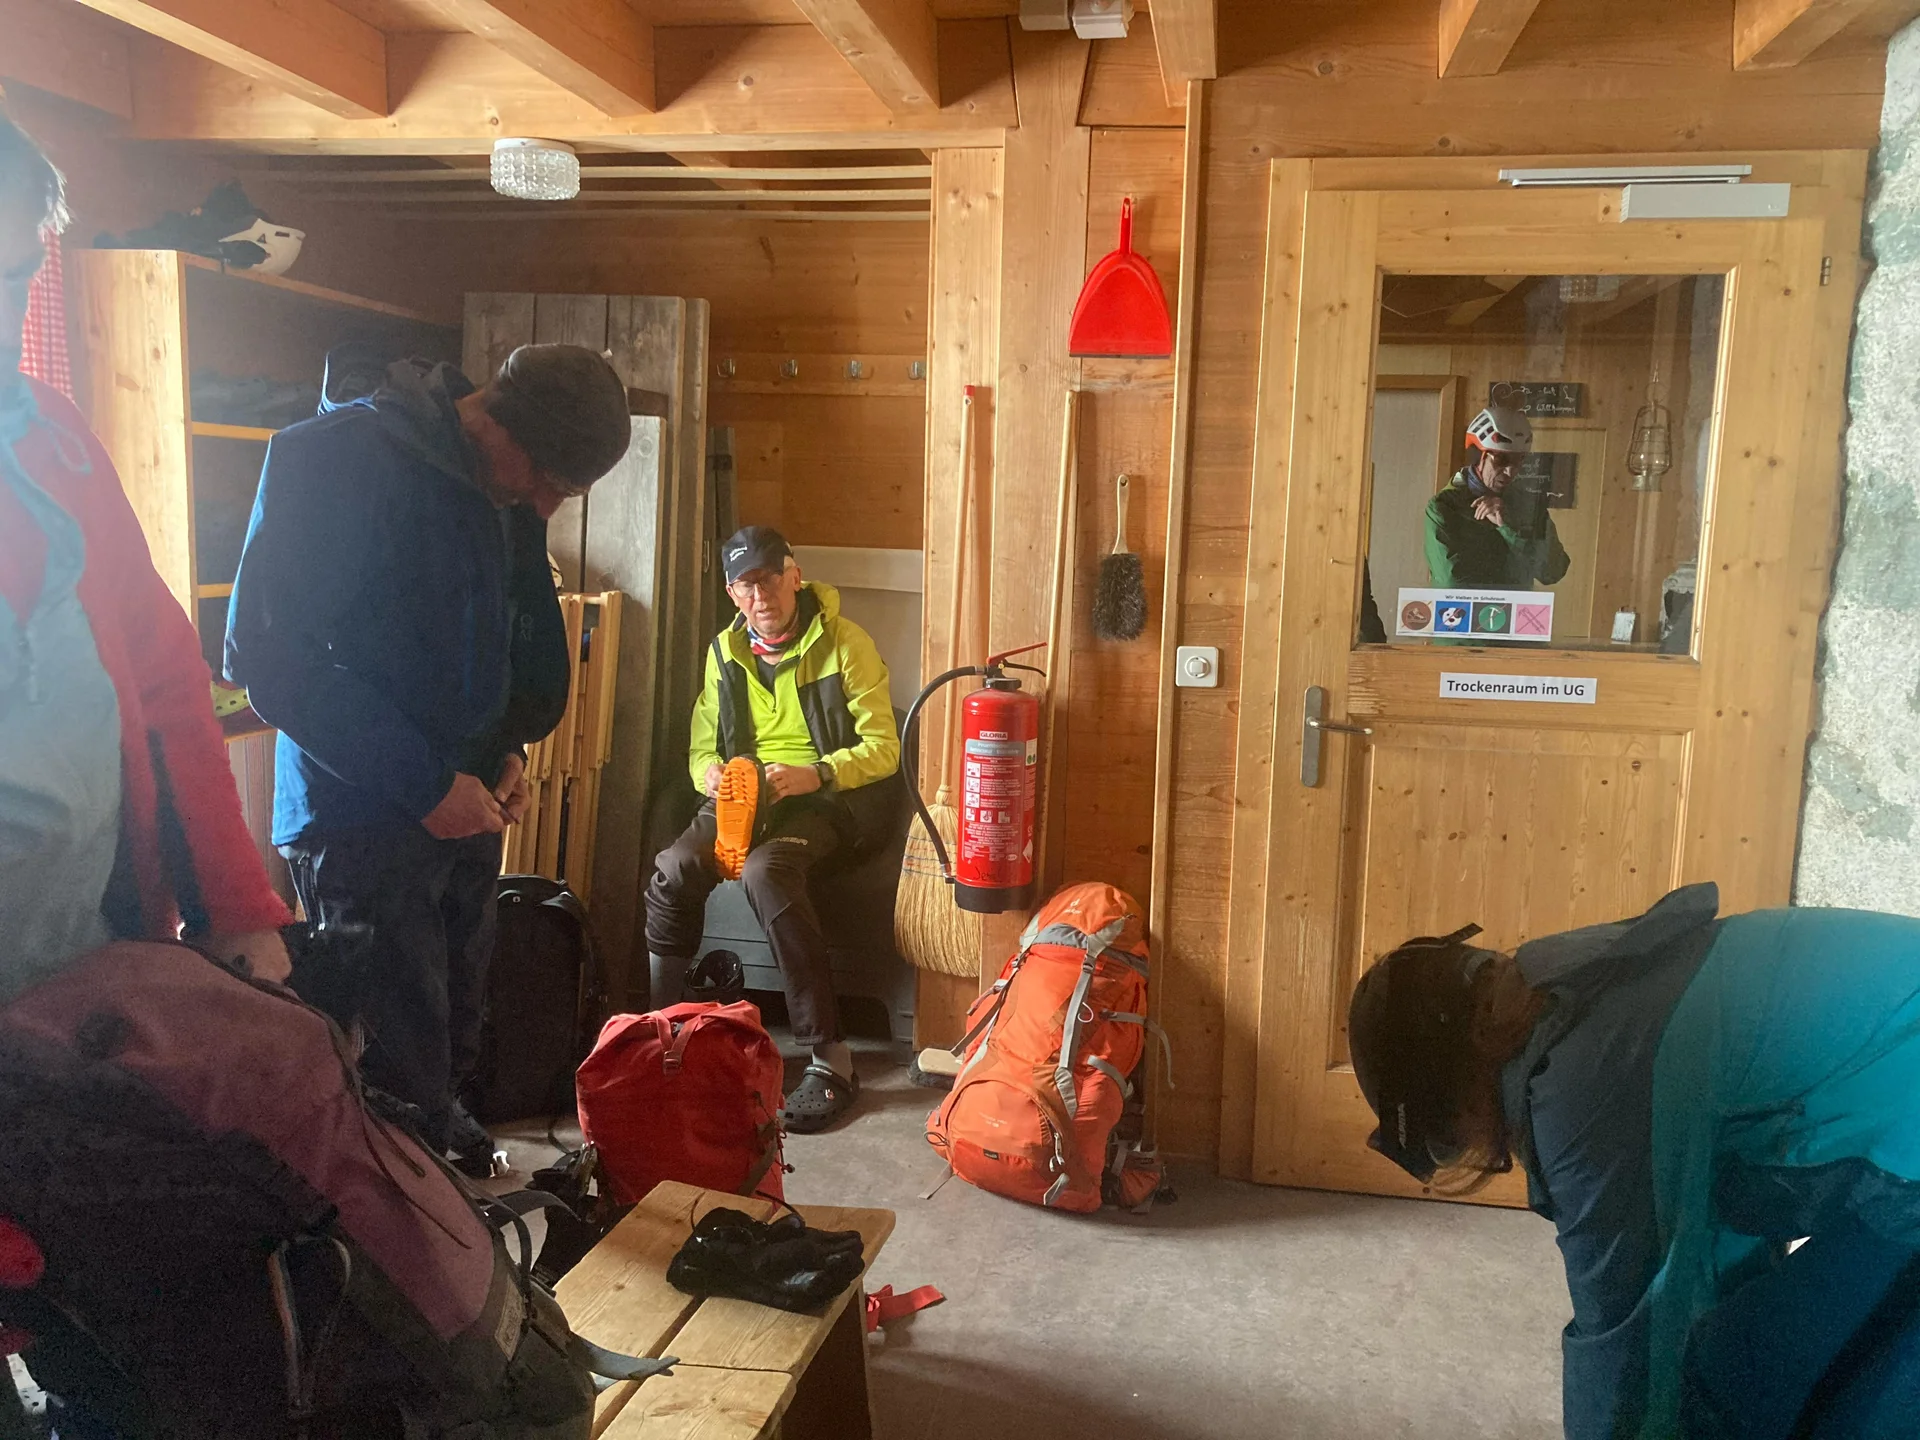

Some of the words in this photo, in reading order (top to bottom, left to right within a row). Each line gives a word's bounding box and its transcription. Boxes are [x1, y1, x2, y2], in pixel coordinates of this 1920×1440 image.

[1447, 680, 1538, 695] Trockenraum
[1542, 682, 1559, 695] im
[1564, 683, 1585, 697] UG
[980, 731, 1008, 739] GLORIA
